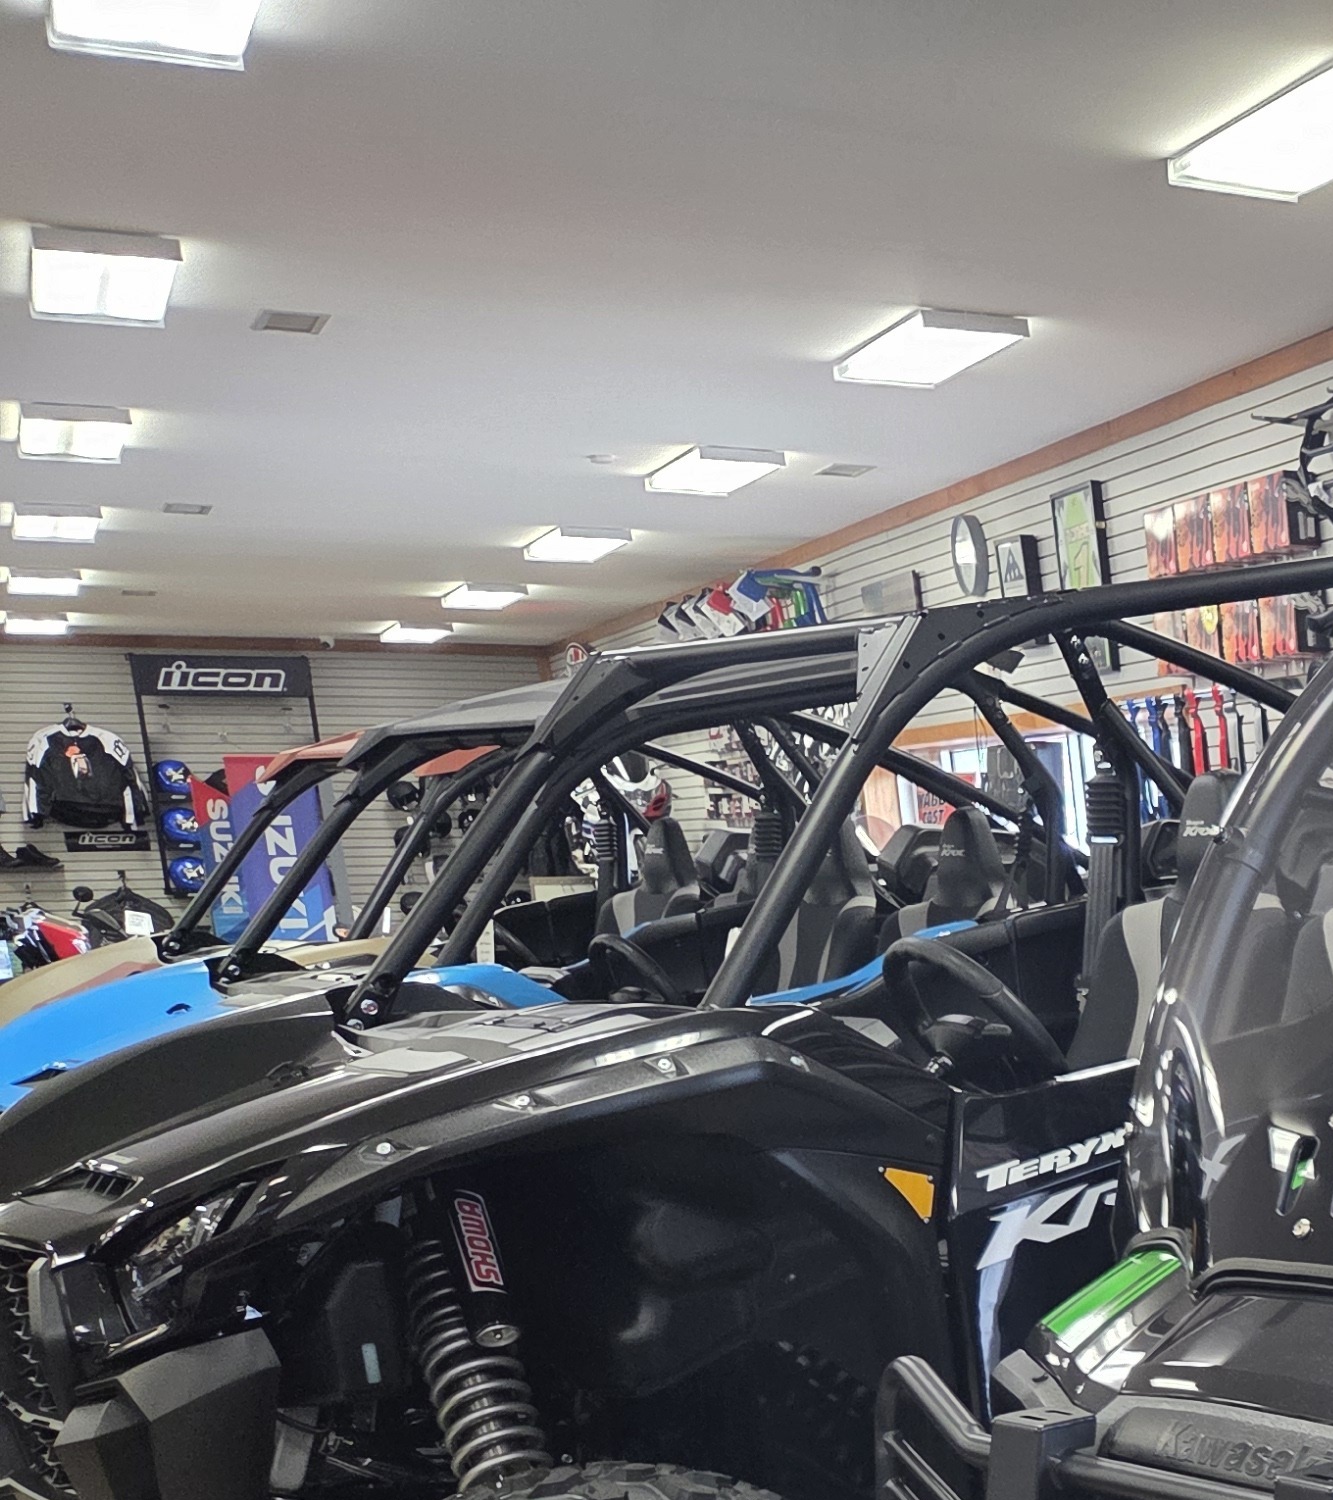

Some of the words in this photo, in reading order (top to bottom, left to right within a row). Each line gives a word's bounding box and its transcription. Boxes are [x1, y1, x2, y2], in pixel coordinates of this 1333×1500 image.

[206, 798, 243, 915] SUZKI
[922, 809, 944, 824] COST
[454, 1197, 504, 1286] SHOWA
